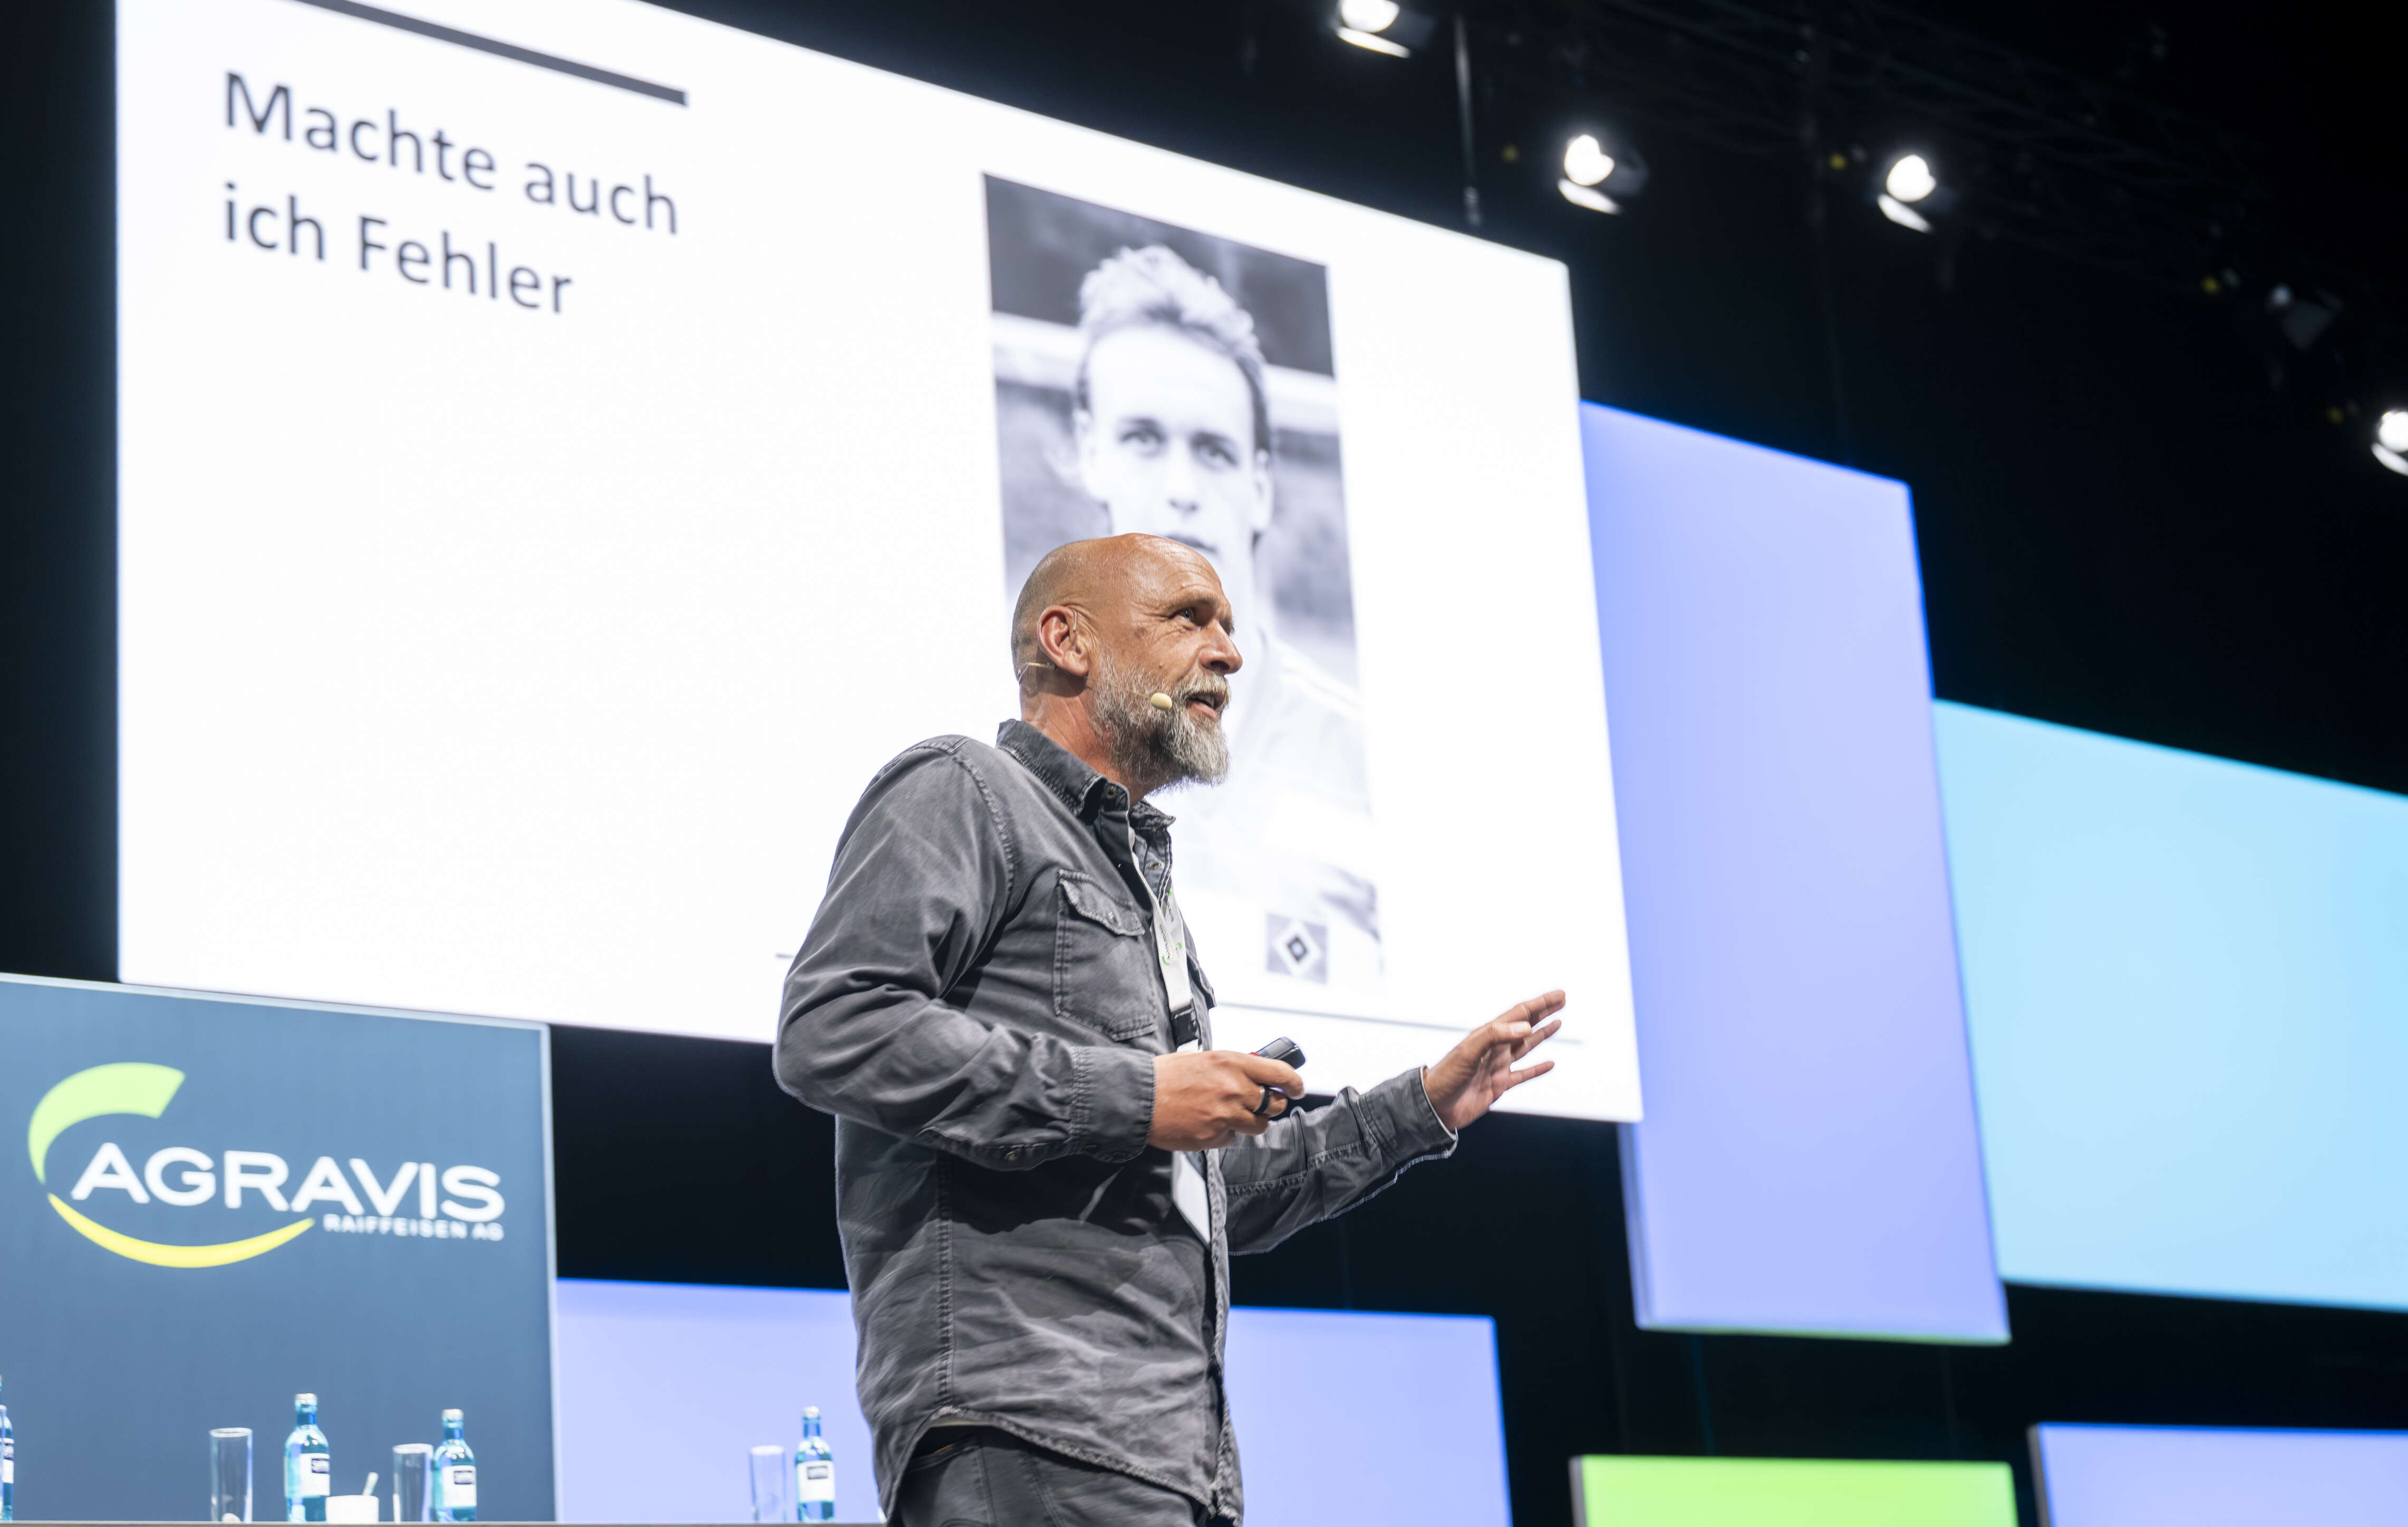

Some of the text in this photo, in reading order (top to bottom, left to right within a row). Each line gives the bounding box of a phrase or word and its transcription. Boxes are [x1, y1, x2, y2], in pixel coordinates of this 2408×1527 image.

[226, 71, 676, 235] Machte auch
[226, 182, 573, 313] ich Fehler
[71, 1142, 506, 1223] AGRAVIS
[323, 1213, 505, 1241] RAIFFEISEN AG
